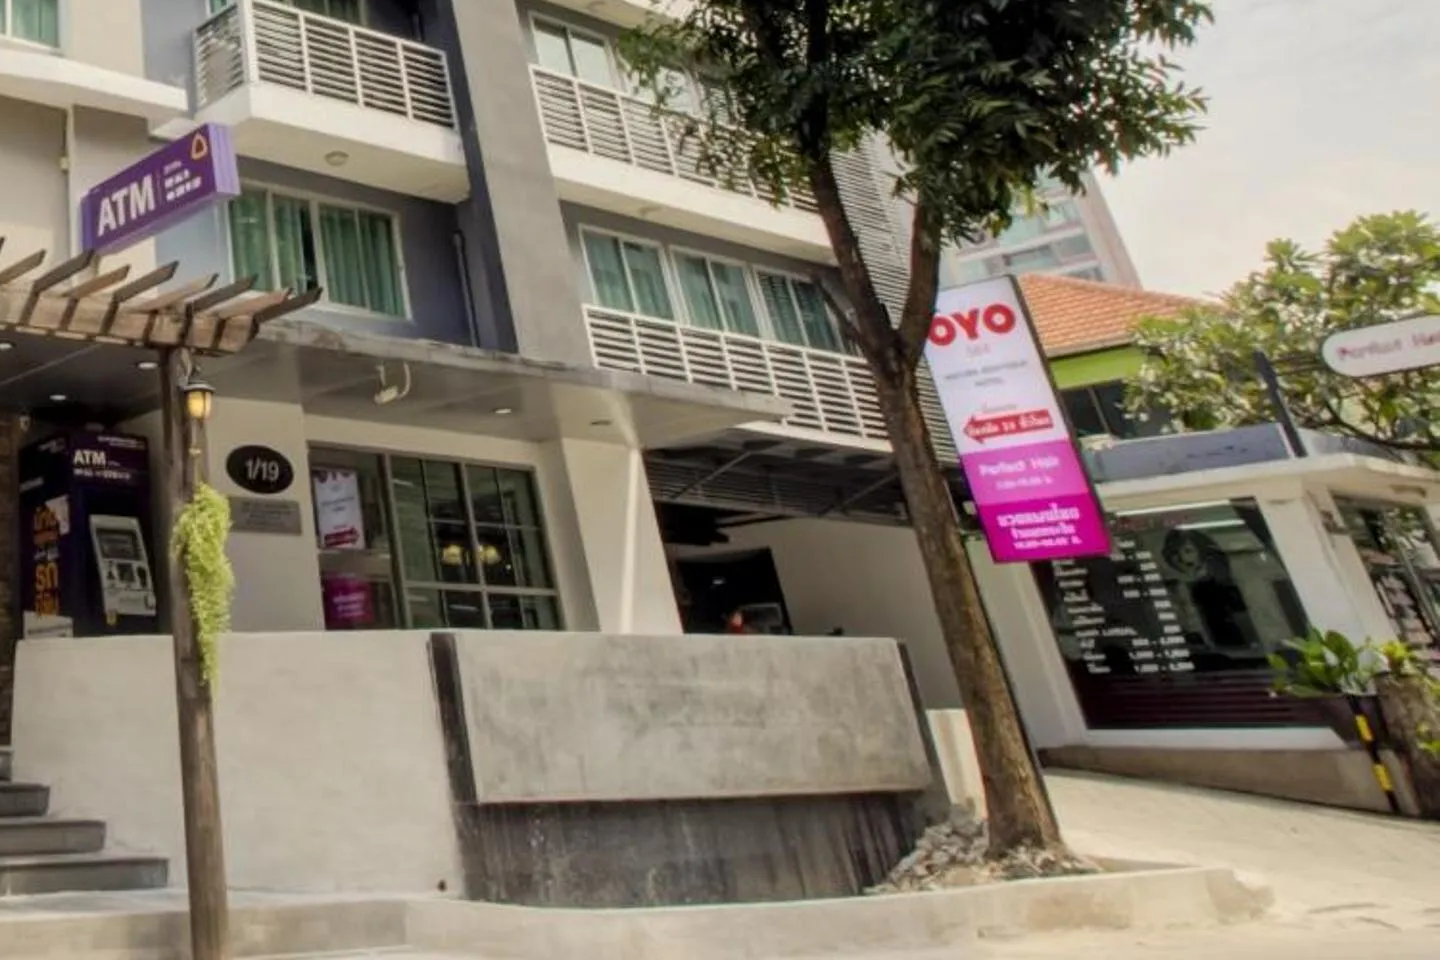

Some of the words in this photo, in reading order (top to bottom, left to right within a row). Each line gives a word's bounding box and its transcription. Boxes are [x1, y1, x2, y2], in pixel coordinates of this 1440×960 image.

[98, 173, 156, 237] ATM
[927, 303, 1016, 346] OYO
[72, 448, 107, 467] ATM
[244, 457, 280, 482] 1/19
